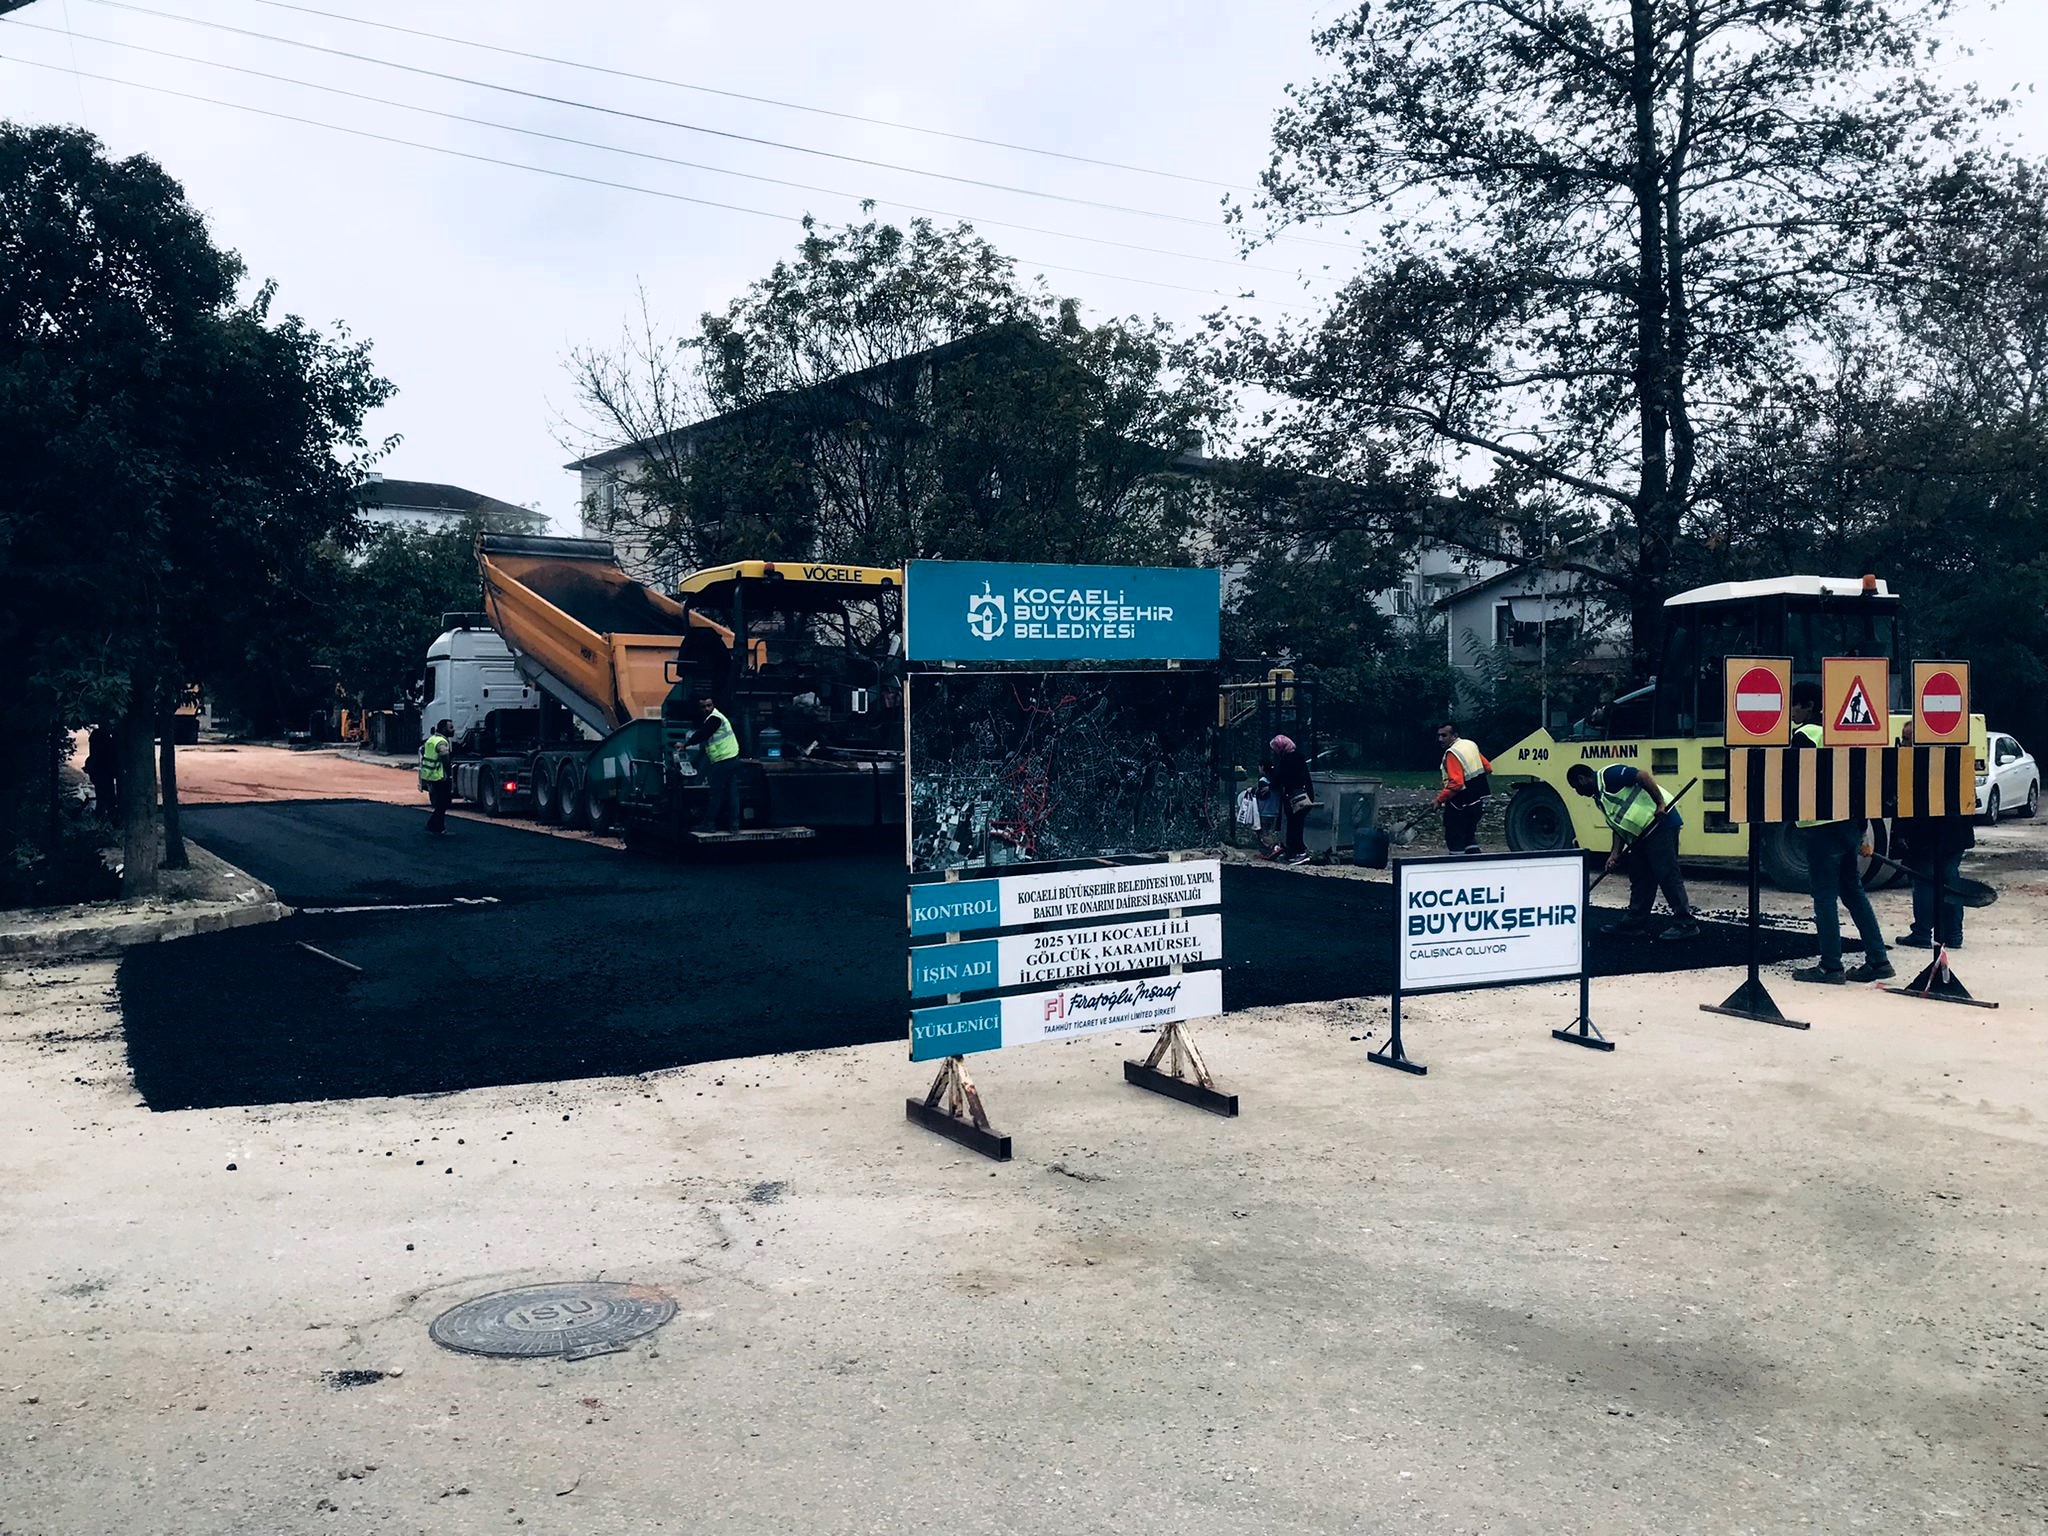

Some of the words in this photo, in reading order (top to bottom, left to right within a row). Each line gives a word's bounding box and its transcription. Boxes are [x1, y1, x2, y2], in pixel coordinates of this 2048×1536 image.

[803, 566, 863, 582] VÖGELE
[1013, 588, 1124, 605] KOCAELİ
[1013, 605, 1173, 623] BÜYÜKŞEHİR
[1014, 623, 1135, 639] BELEDİYESİ
[1518, 748, 1530, 760] AP
[1532, 748, 1549, 760] 240
[1580, 744, 1638, 759] AMMANN
[1018, 886, 1057, 904] KOCAELİ
[1059, 880, 1116, 899] BÜYÜKŞEHİR
[1117, 875, 1168, 894] BELEDİYESİ
[1170, 874, 1186, 886] YOL
[1187, 872, 1215, 884] YAPIM,
[1408, 887, 1505, 909] KOCAELİ
[914, 899, 998, 922] KONTROL
[1033, 905, 1062, 919] BAKIM
[1066, 903, 1079, 915] VE
[1080, 899, 1115, 914] ONARIM
[1116, 894, 1151, 910] DAİRESİ
[1152, 887, 1202, 907] BAŞKANLIĞI
[1408, 904, 1577, 936] BÜYÜKŞEHİR
[1034, 936, 1064, 949] 2025
[1067, 931, 1097, 946] YILI
[1102, 922, 1167, 942] KOCAELİ
[1170, 919, 1190, 934] İLİ
[1026, 946, 1091, 966] GÖLCÜK
[1102, 936, 1201, 957] KARAMÜRSEL
[1409, 948, 1463, 960] ÇALIŞINCA
[1465, 944, 1507, 956] OLUYOR
[923, 963, 959, 984] İŞİN
[962, 960, 992, 977] ADI
[1020, 962, 1091, 984] İLÇELERİ
[1094, 960, 1124, 974] YOL
[1127, 950, 1203, 970] YAPILMASI
[914, 1014, 999, 1040] YÜKLENİCİ
[1044, 1023, 1072, 1034] TAAHHÜT
[1073, 1019, 1098, 1029] TİCARET
[1108, 1014, 1130, 1024] SANAYİ
